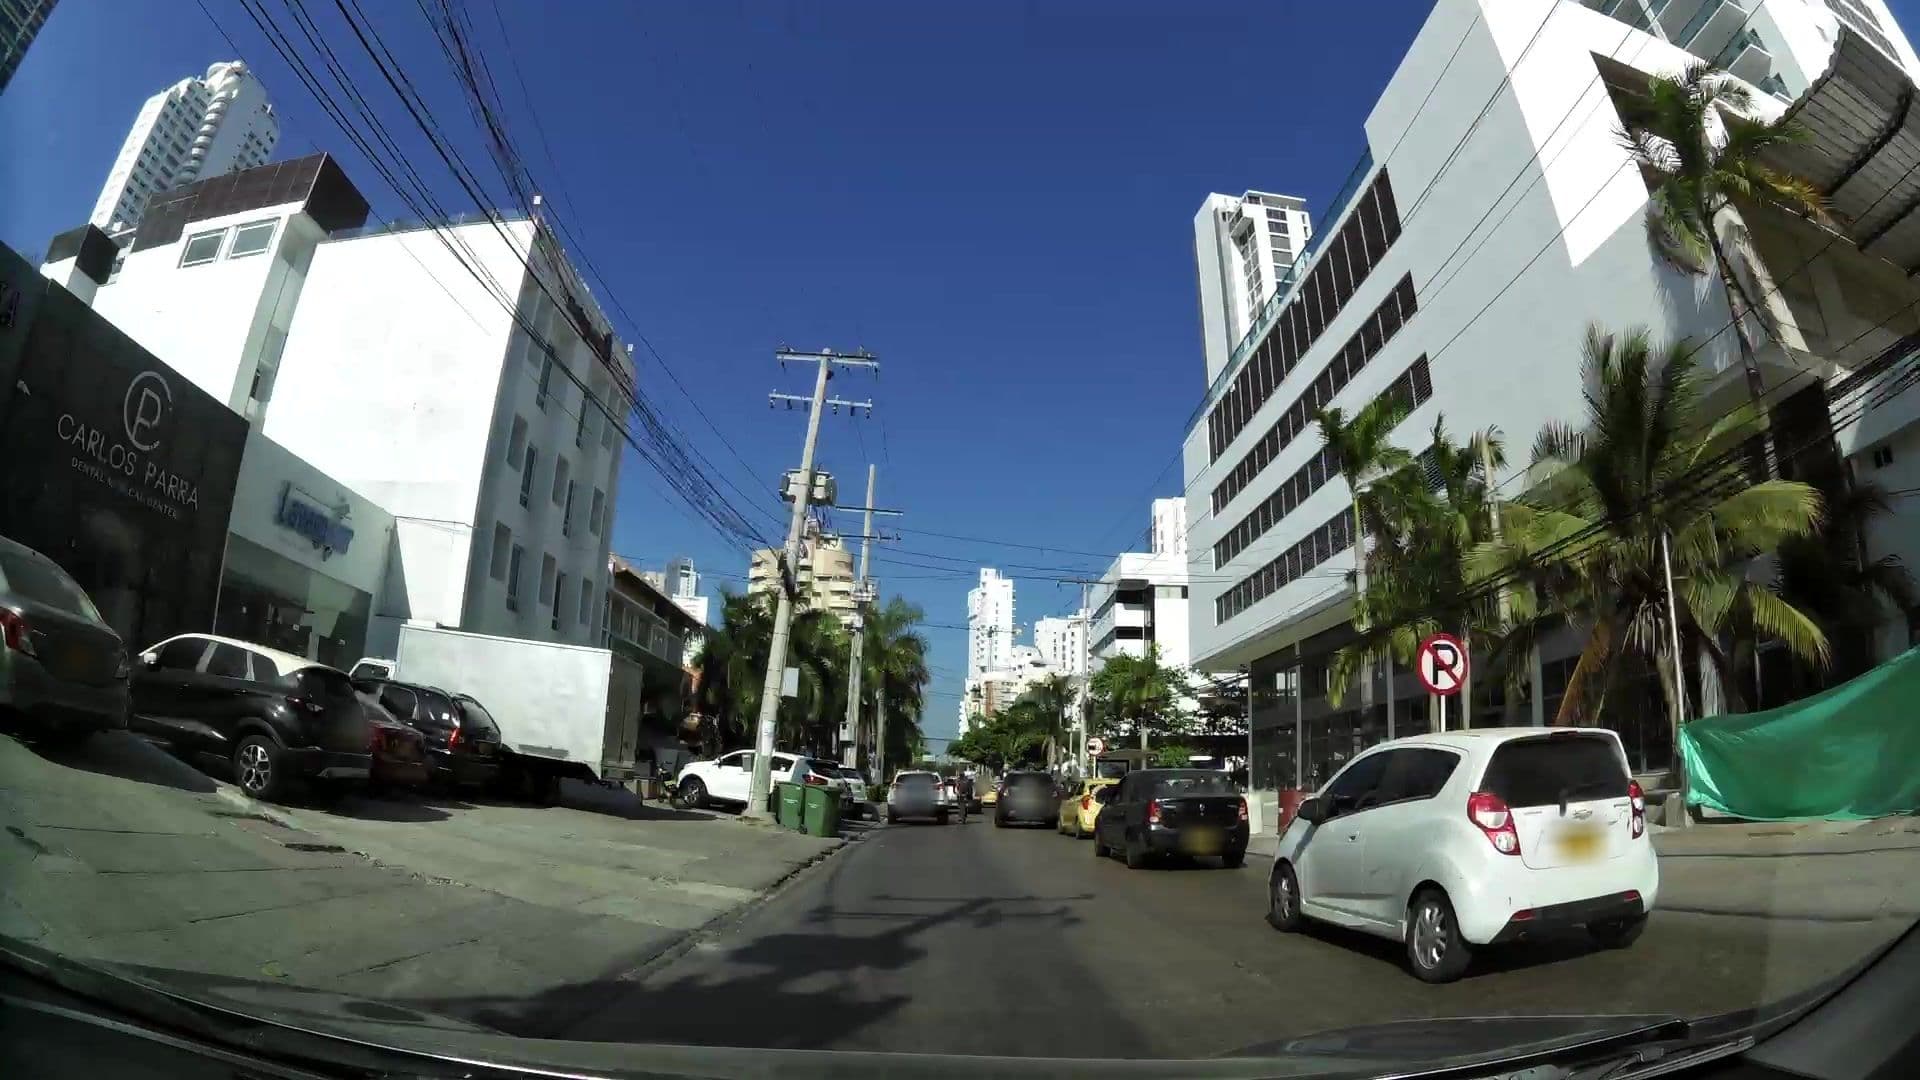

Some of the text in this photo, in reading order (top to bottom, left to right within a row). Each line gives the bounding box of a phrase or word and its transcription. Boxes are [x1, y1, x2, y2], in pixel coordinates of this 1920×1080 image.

[57, 413, 137, 476] CARLOS
[144, 461, 199, 511] PARRA
[1432, 643, 1458, 685] P
